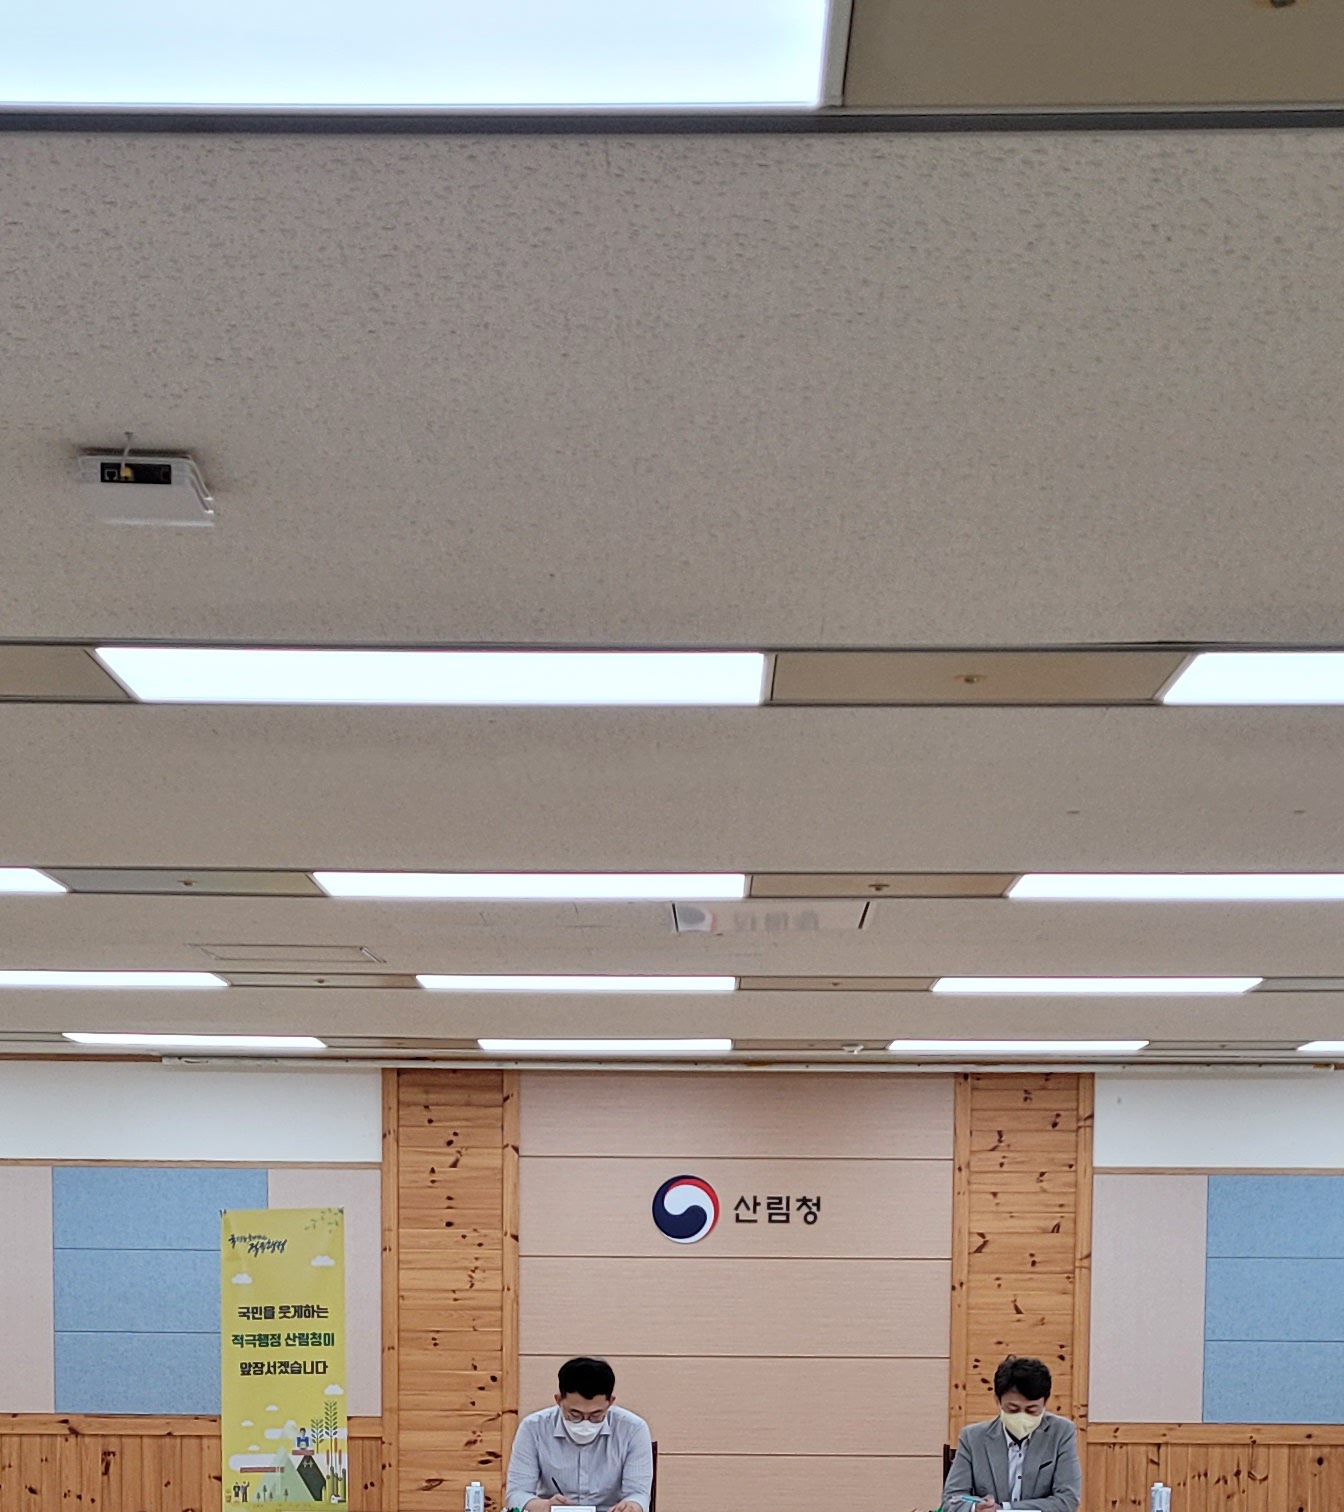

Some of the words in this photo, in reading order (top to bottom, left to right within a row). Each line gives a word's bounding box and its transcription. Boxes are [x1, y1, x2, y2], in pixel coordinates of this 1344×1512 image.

[733, 1195, 821, 1225] 산림청
[238, 1305, 275, 1320] 국민을
[278, 1304, 329, 1320] 웃게하는
[231, 1333, 282, 1348] 적극행정
[285, 1332, 335, 1347] 산림청이
[239, 1361, 328, 1376] 앞장서겠습니다
